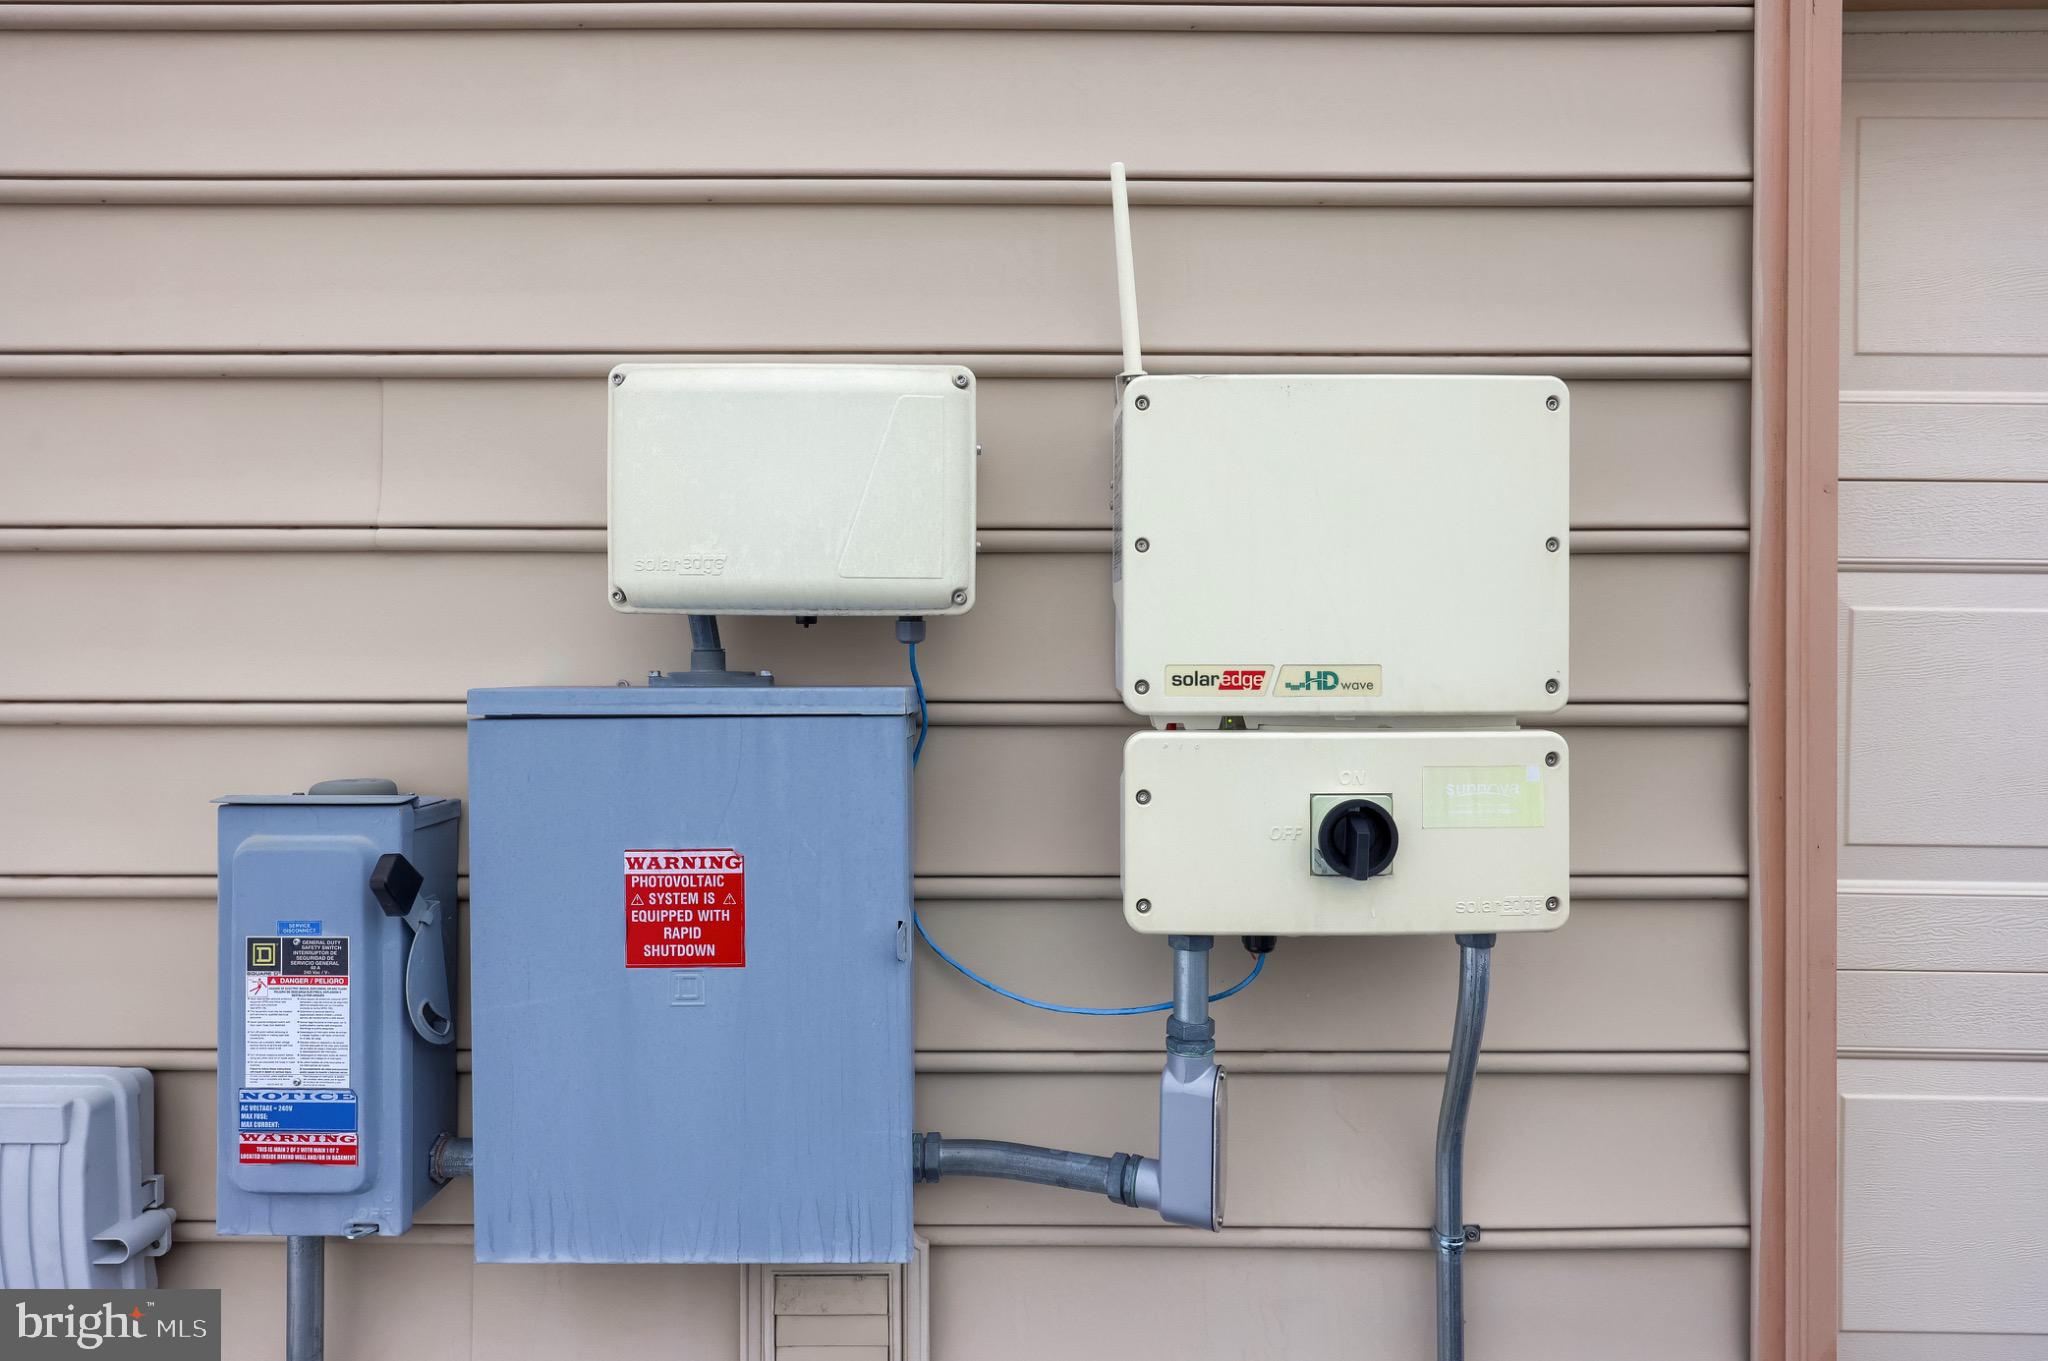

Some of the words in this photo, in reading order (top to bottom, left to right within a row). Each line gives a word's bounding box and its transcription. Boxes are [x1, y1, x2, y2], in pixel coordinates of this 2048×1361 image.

[634, 555, 725, 575] solaredge
[1171, 670, 1264, 690] solaredge
[1304, 670, 1339, 691] HD
[1340, 680, 1374, 691] wave
[1339, 769, 1366, 786] ON
[1270, 826, 1303, 841] OFF
[625, 855, 742, 870] WARNING
[631, 875, 725, 888] PHOTOVOLTAIC
[648, 892, 699, 905] SYSTEM
[703, 892, 715, 904] IS
[1455, 897, 1543, 915] solaredge
[631, 909, 693, 923] EQUIPPED
[697, 909, 730, 922] WITH
[663, 926, 702, 939] RAPID
[643, 944, 716, 957] SHUTDOWN
[240, 1092, 356, 1100] NOTICE
[240, 1134, 356, 1143] WARNING
